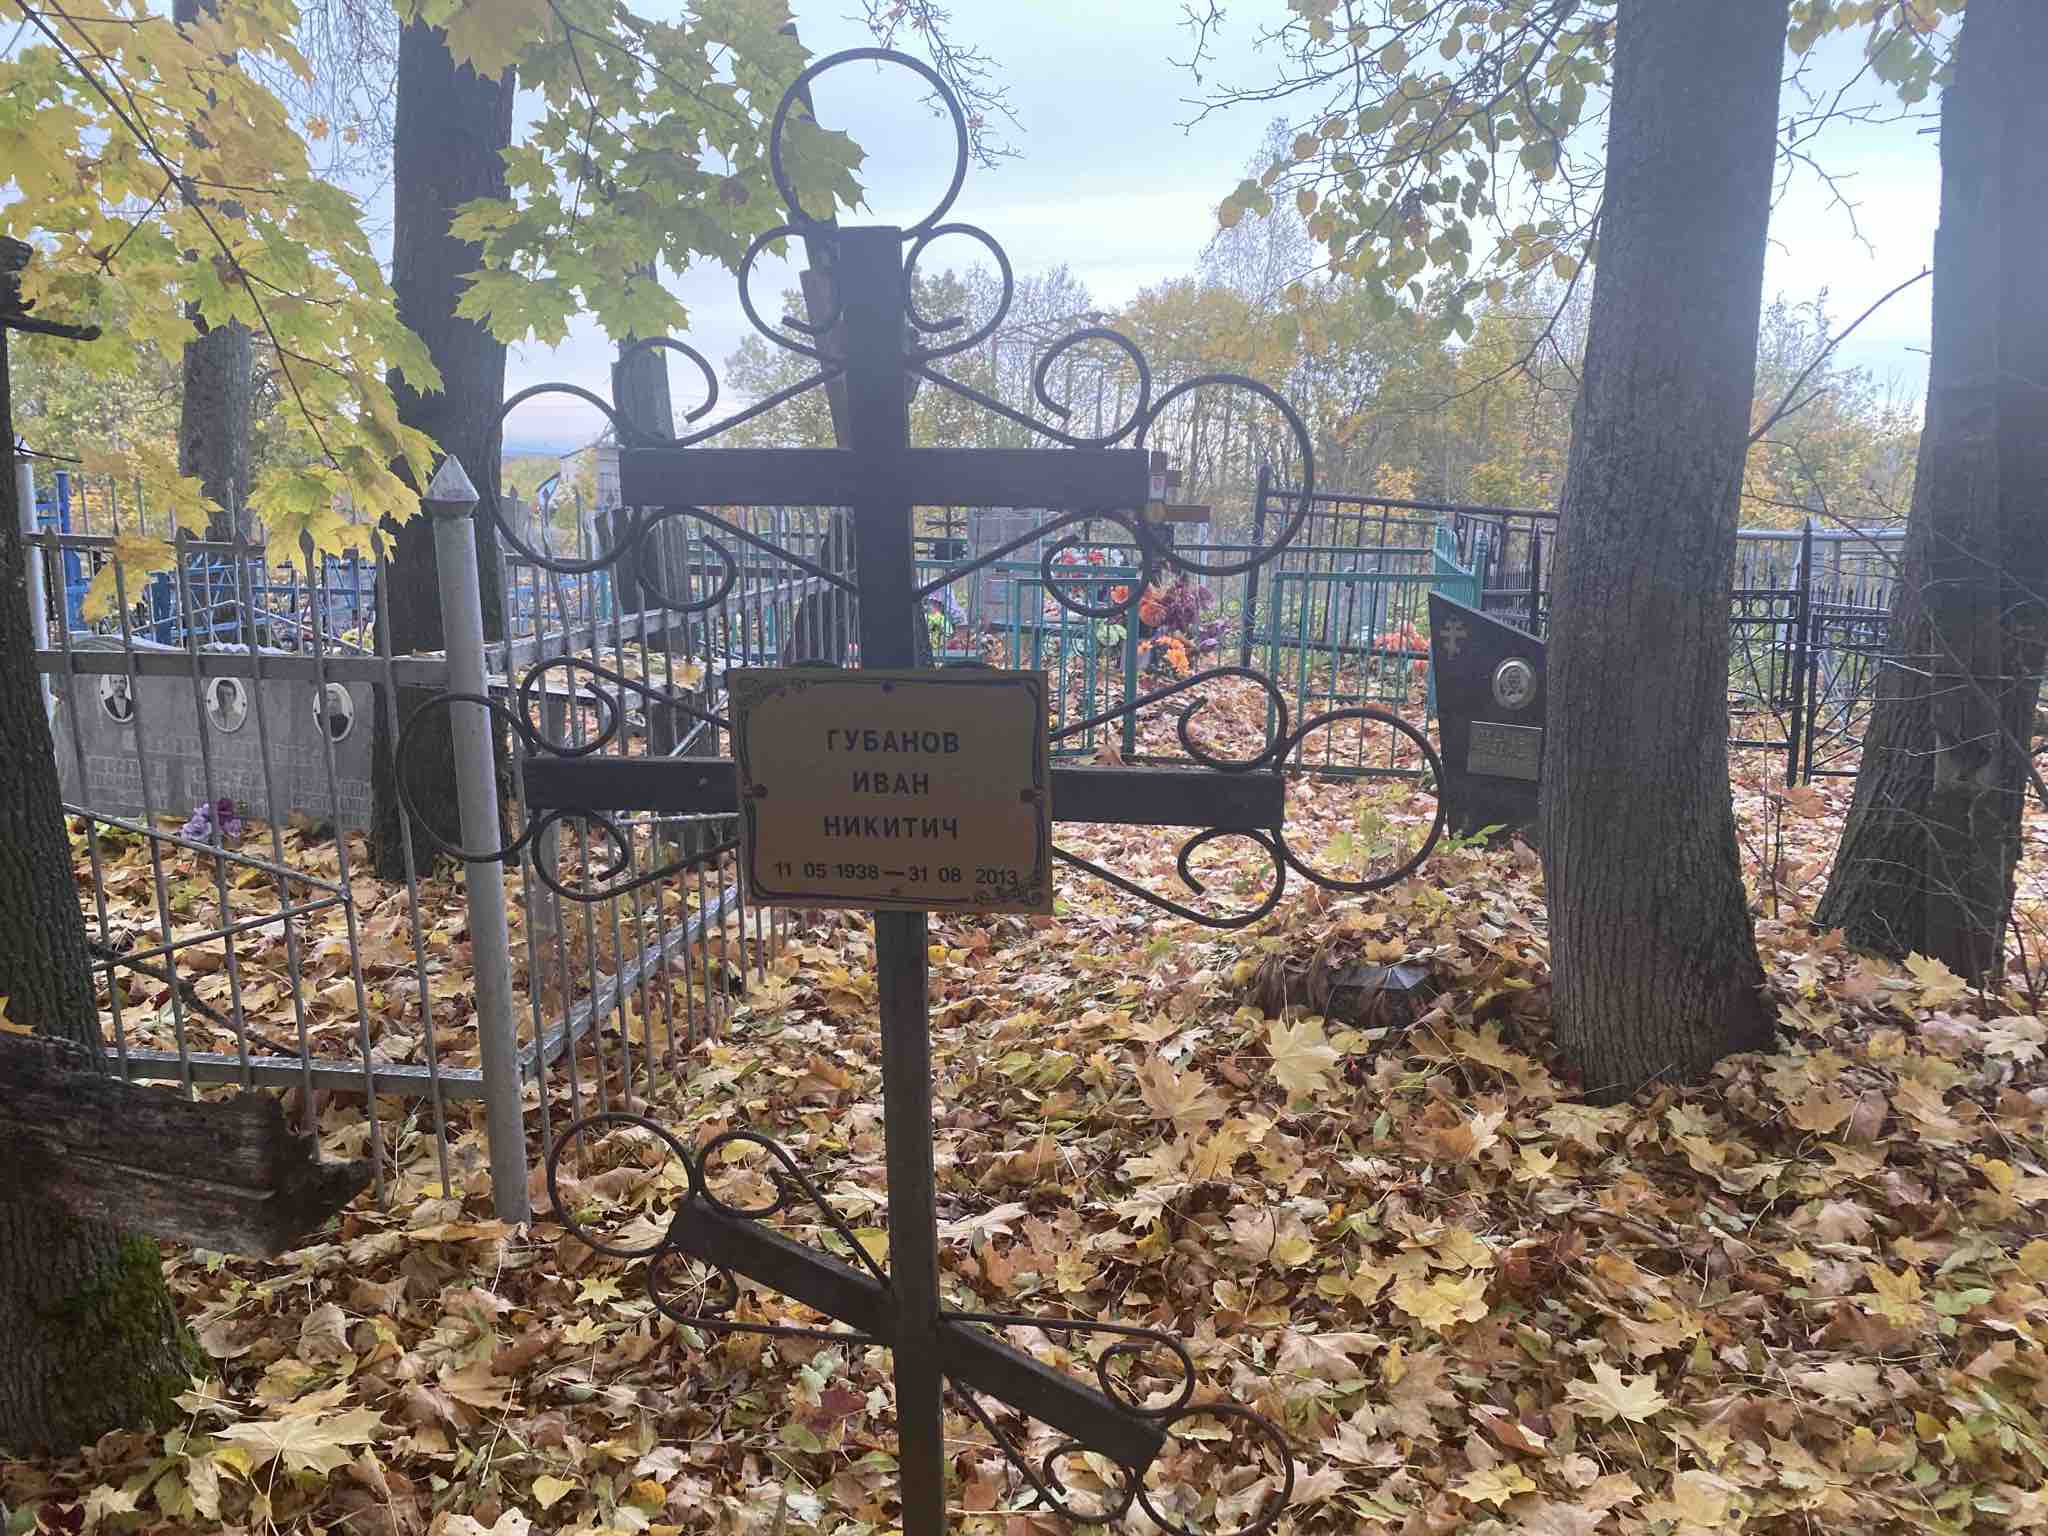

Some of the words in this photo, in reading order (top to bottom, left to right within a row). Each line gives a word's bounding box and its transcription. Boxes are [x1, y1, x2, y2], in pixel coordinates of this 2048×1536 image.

[825, 729, 960, 753] ГУБАНОВ
[852, 770, 929, 795] ИВАН
[824, 815, 959, 840] НИКИТИЧ
[938, 866, 962, 883] 08
[975, 868, 1018, 885] 2013
